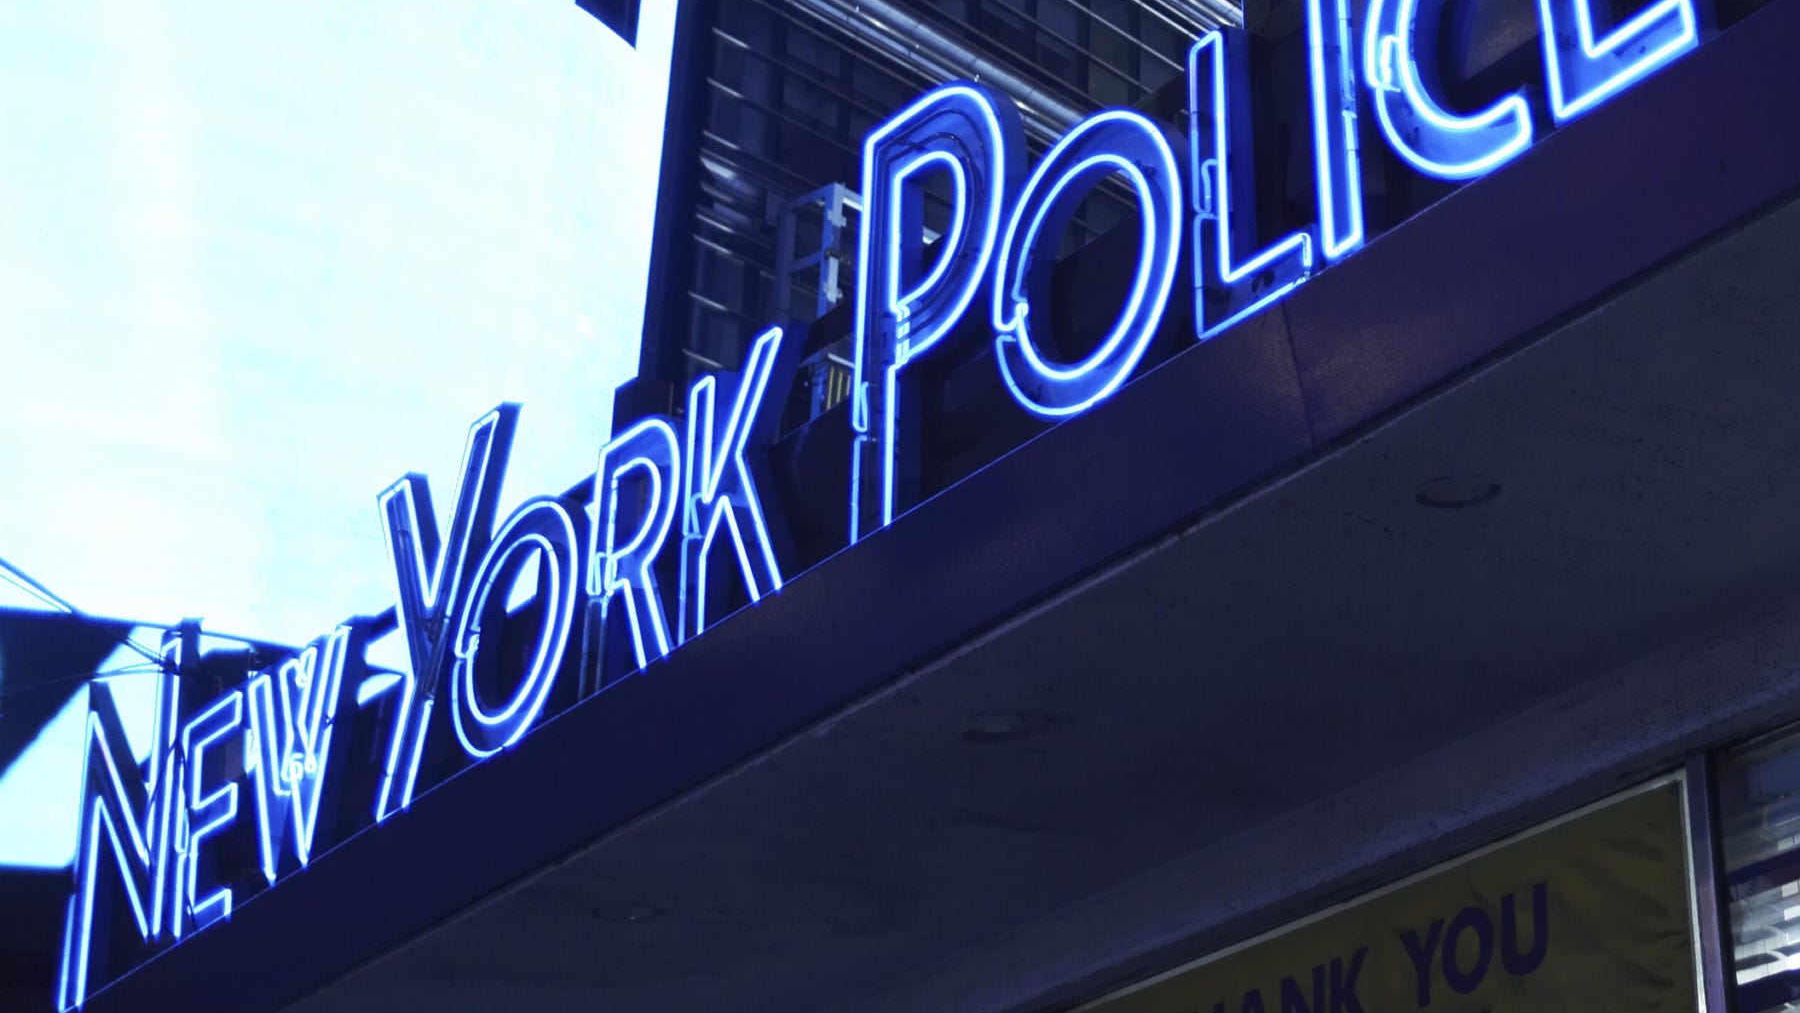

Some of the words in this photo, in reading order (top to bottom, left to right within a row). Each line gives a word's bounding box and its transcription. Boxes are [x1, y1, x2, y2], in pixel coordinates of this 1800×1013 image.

[57, 616, 354, 1013] NEW
[377, 326, 786, 824] YORK
[1400, 879, 1549, 1009] YOU
